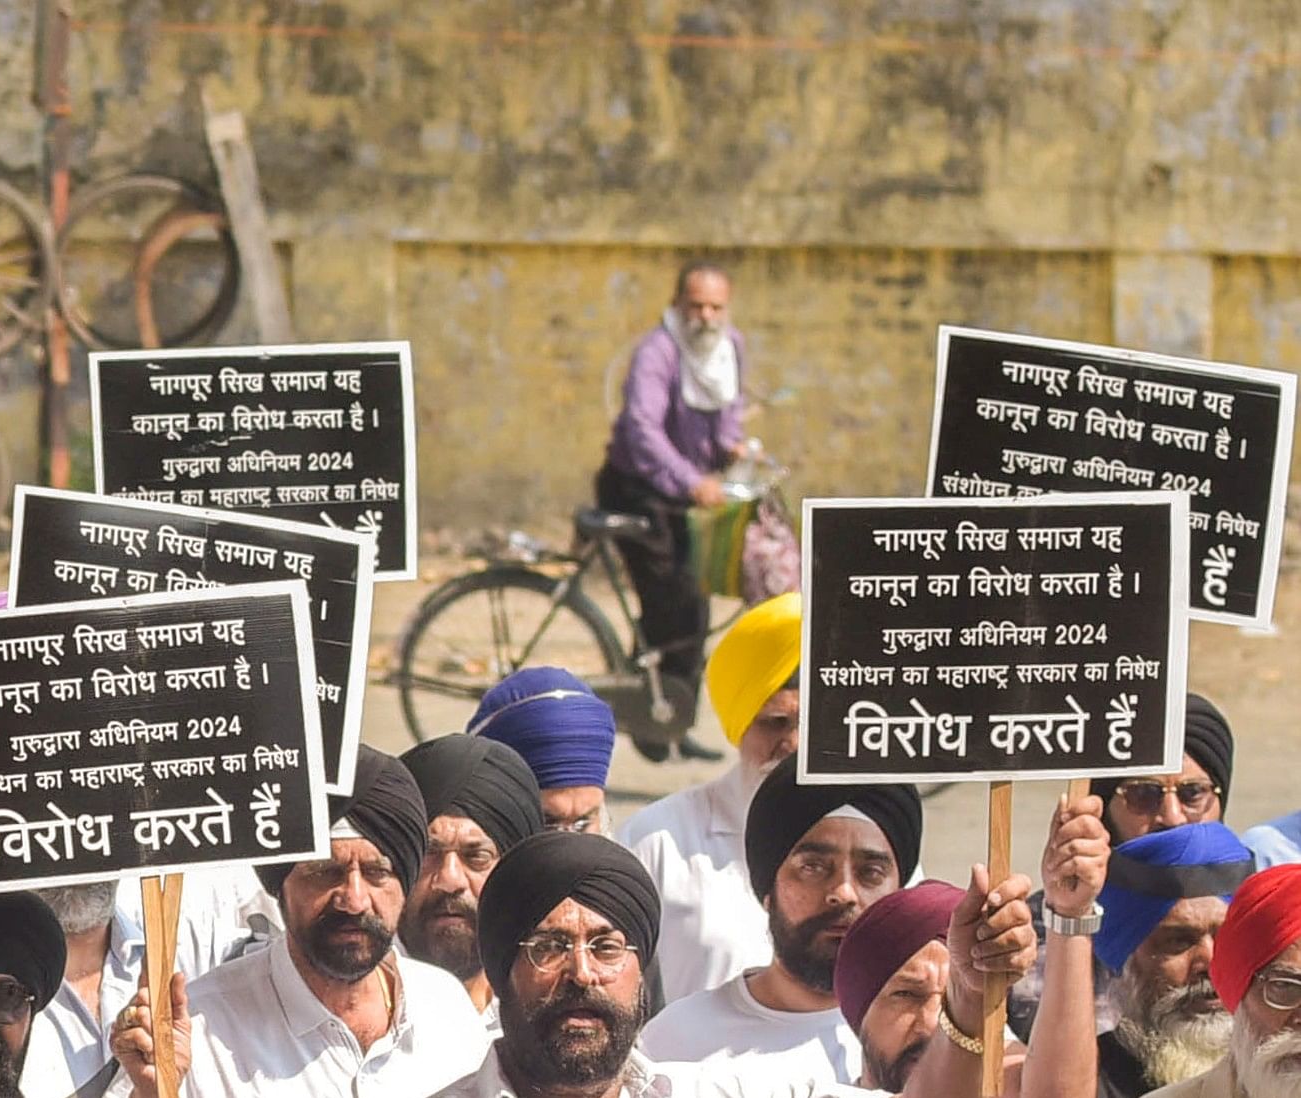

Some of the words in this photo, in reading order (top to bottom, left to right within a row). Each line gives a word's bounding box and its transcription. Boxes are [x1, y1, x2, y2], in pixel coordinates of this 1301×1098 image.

[149, 374, 213, 401] नागपूर
[218, 367, 265, 393] सिख
[270, 371, 328, 392] समाज
[333, 370, 361, 394] यह
[1002, 361, 1071, 397] नागपूर
[1077, 365, 1127, 398] सिख
[1133, 380, 1197, 409] समाज
[1203, 391, 1235, 419] यह
[873, 529, 948, 560] नागपूर
[955, 521, 1009, 551] सिख
[1017, 527, 1084, 550] समाज
[1091, 526, 1123, 553] यह
[849, 575, 919, 607] कानून
[927, 575, 960, 597] का
[968, 566, 1033, 596] विरोध
[1040, 573, 1100, 595] करता
[1107, 563, 1124, 598] है
[72, 624, 128, 654] सिख
[135, 622, 204, 649] समाज
[211, 619, 245, 645] यह
[882, 628, 952, 654] गुरुद्वारा
[959, 621, 1047, 646] अधिनियम
[1055, 624, 1107, 645] 2024
[819, 660, 895, 686] संशोधन
[902, 667, 930, 685] का
[936, 665, 1009, 689] महाराष्ट्र
[1016, 664, 1078, 683] सरकार
[1084, 663, 1109, 682] का
[1115, 655, 1160, 681] निषेध
[843, 698, 972, 758] विरोध
[989, 695, 1090, 754] करते
[1105, 693, 1138, 760] हैं
[130, 787, 234, 850] करते
[250, 782, 281, 849] हैं
